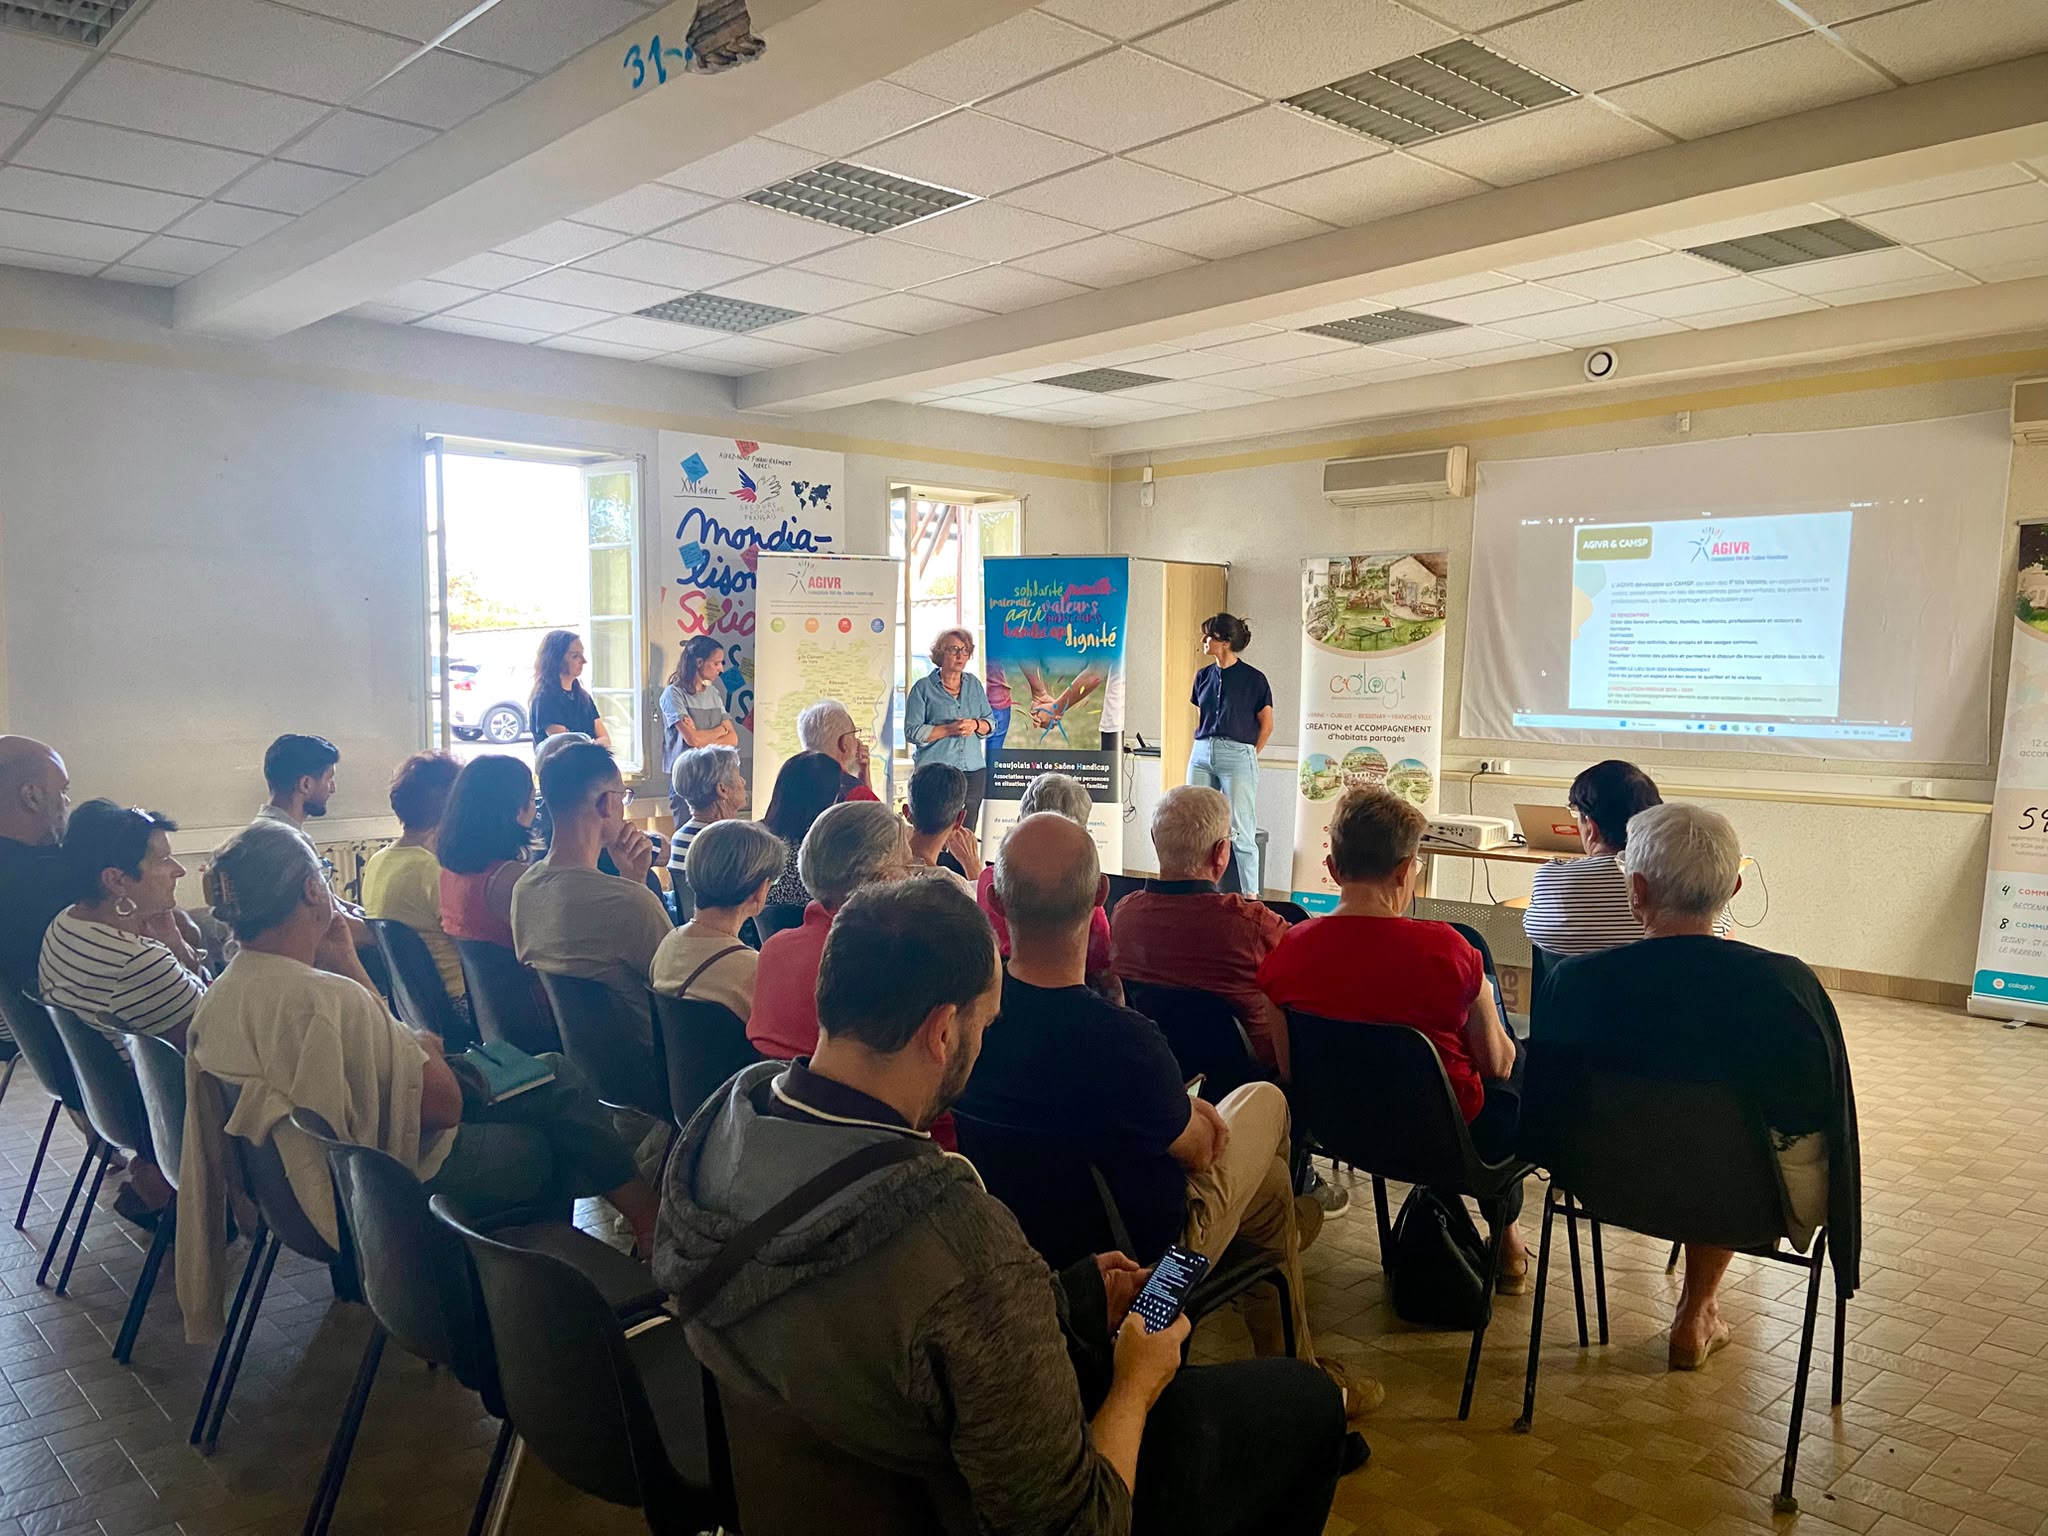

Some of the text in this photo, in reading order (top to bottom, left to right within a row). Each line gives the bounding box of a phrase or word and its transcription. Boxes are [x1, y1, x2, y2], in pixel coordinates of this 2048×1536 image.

[1583, 538, 1648, 550] AGIVR & CAMSP
[1712, 542, 1750, 556] AGIVR
[808, 576, 842, 589] AGIVR
[1014, 578, 1064, 598] solidarité
[1042, 596, 1098, 614] valeurs
[1066, 622, 1118, 654] dignité
[1354, 724, 1431, 733] ACCOMPAGNEMENT
[1370, 735, 1405, 744] partagés
[994, 761, 1030, 770] Beaujolais
[1077, 763, 1110, 772] Handicap
[2002, 885, 2010, 895] 4
[2000, 918, 2009, 929] 8
